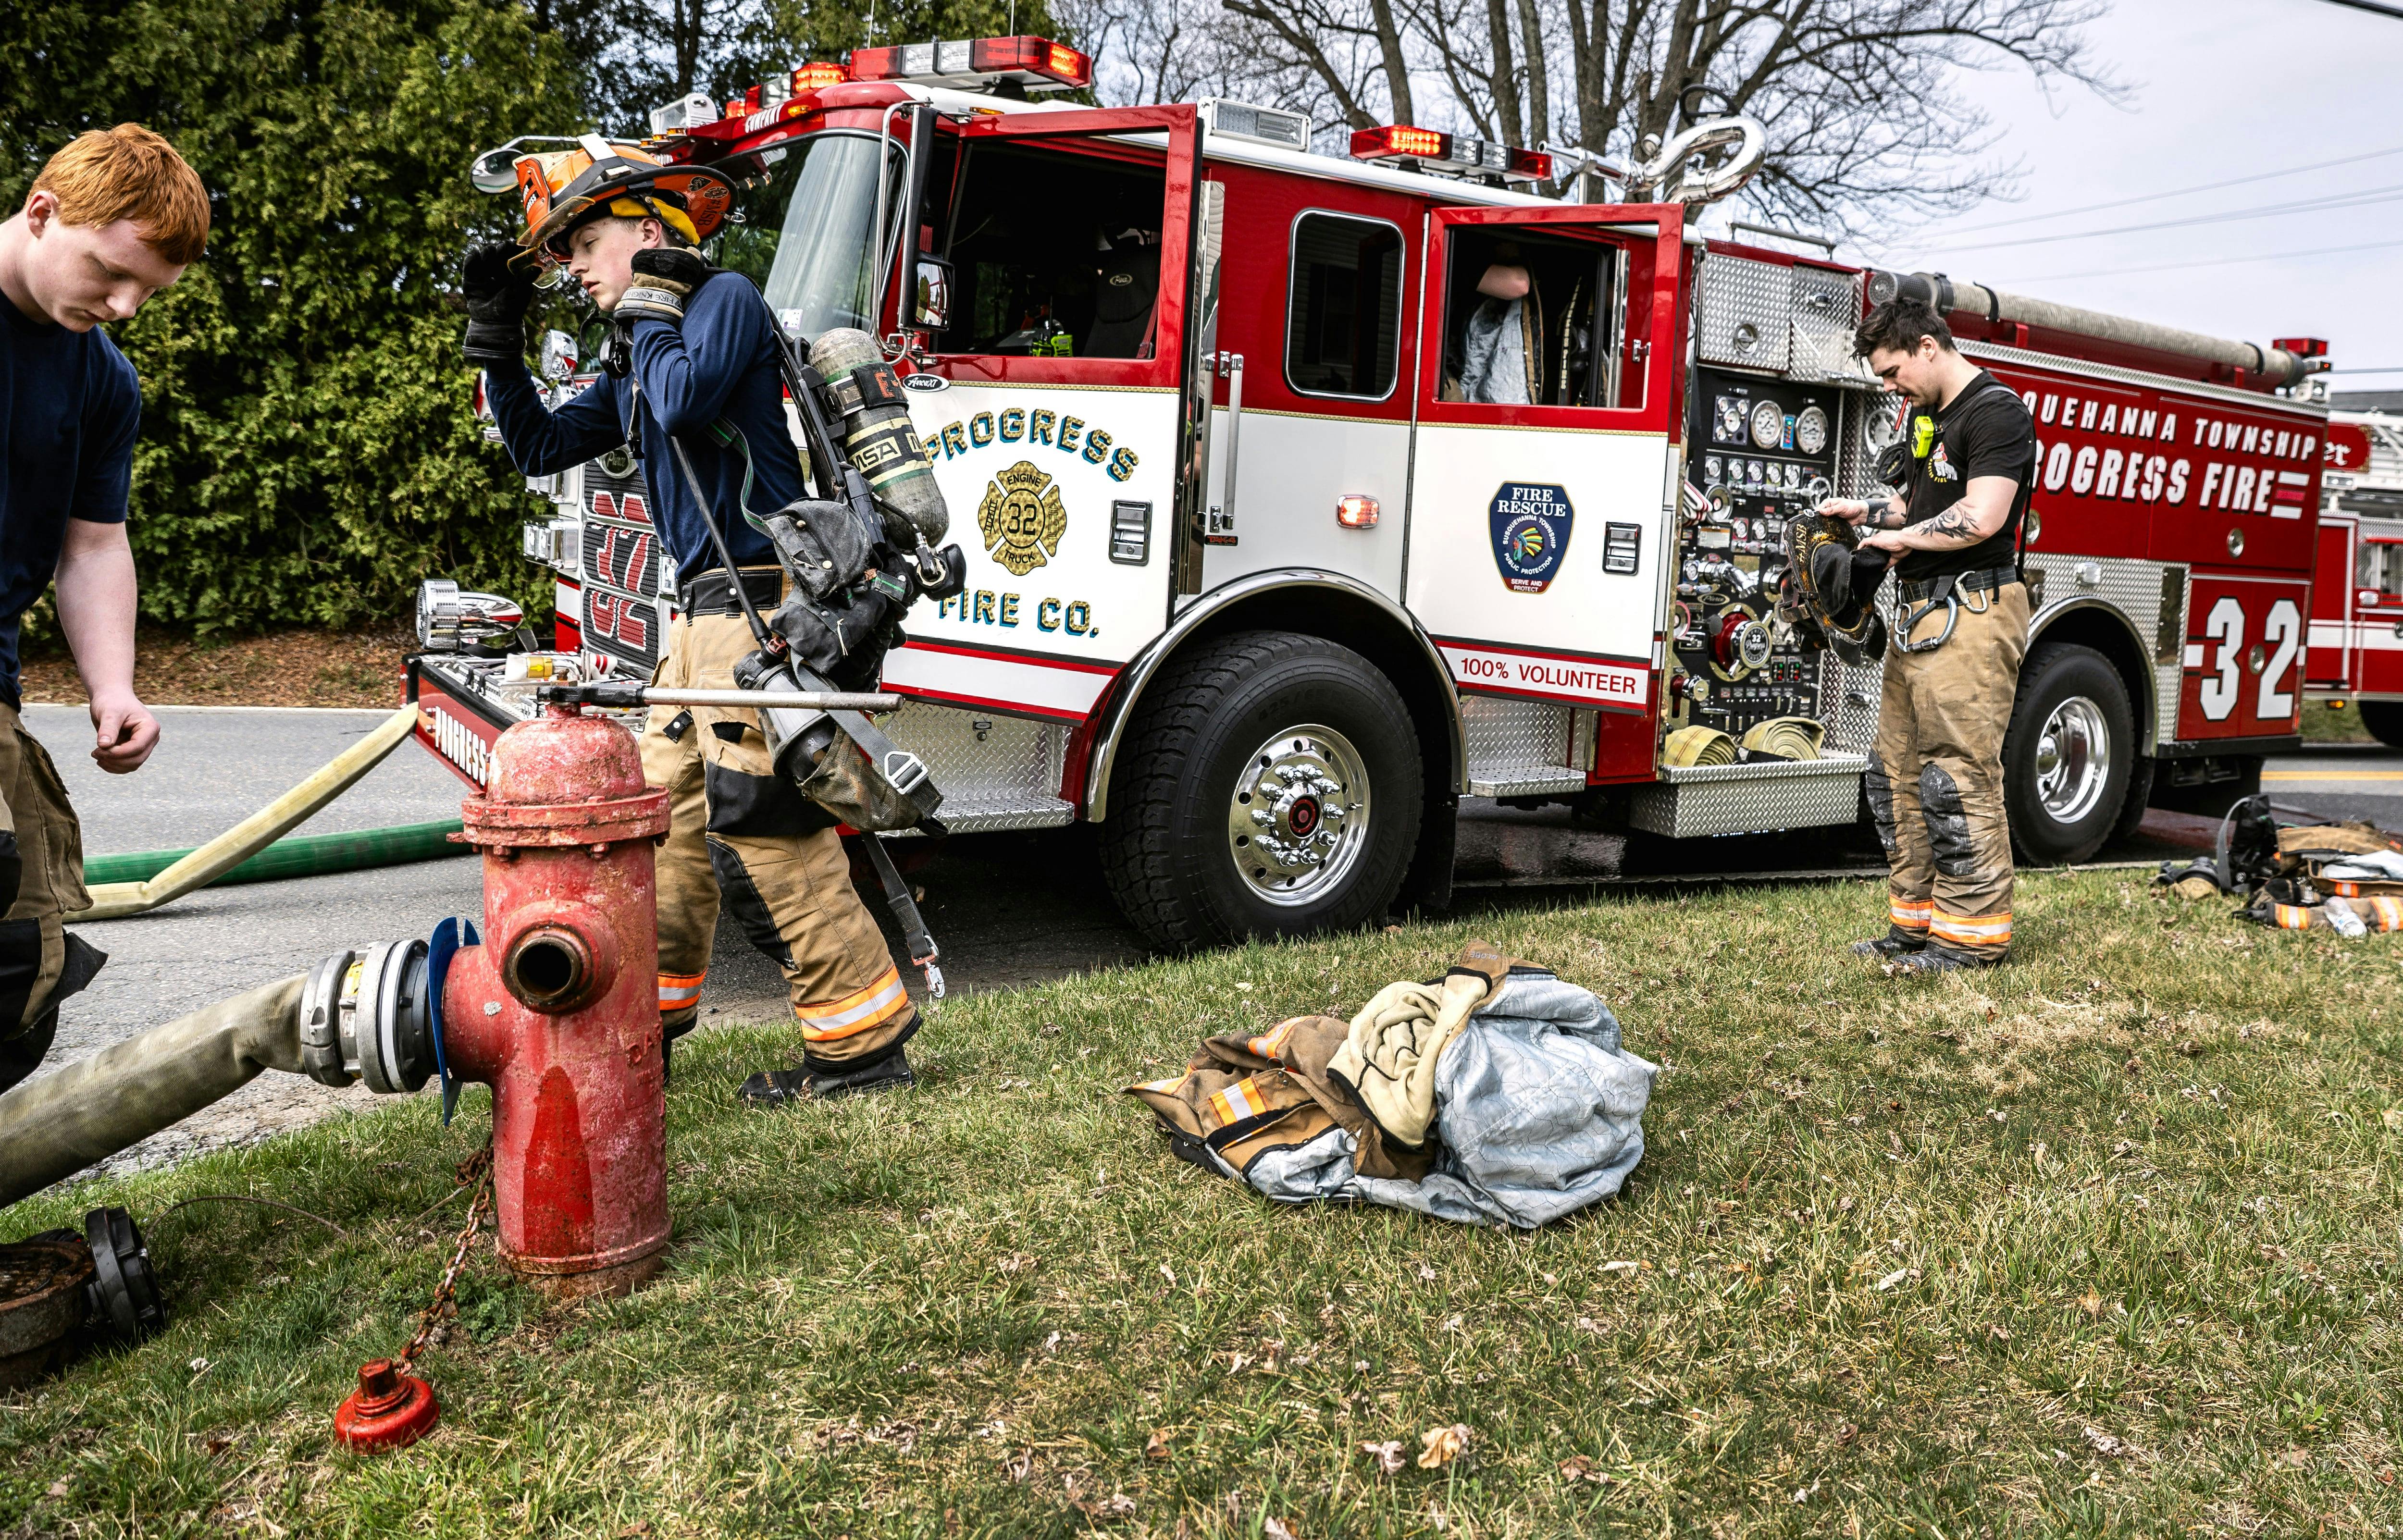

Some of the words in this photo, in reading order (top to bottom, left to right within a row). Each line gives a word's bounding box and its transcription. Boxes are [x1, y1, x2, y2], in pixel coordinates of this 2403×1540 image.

[698, 199, 723, 226] #MSB
[626, 291, 653, 299] KNIGHT
[656, 293, 674, 304] FIRE
[920, 407, 1140, 482] PROGRESS
[2194, 418, 2316, 460] TOWNSHIP
[849, 442, 898, 471] MSA
[1007, 475, 1042, 487] ENGINE
[1512, 487, 1553, 502] FIRE
[2199, 462, 2275, 512] FIRE
[1007, 503, 1038, 536] 32
[1498, 500, 1566, 517] RESCUE
[1503, 515, 1537, 544] SUSQUEHANNA
[1538, 517, 1556, 549] TOWNSHIP
[1795, 523, 1807, 563] #MSB
[1003, 548, 1036, 564] TRUCK
[1504, 553, 1520, 571] PUBLIC
[1521, 556, 1553, 575] PROTECTION
[939, 588, 1020, 628] FIRE
[1038, 597, 1100, 638] CO.
[1752, 634, 1761, 642] 32
[2200, 597, 2301, 720] 32
[1461, 658, 1509, 678] 100%
[1519, 664, 1636, 694] VOLUNTEER
[435, 705, 486, 787] PROGRESS
